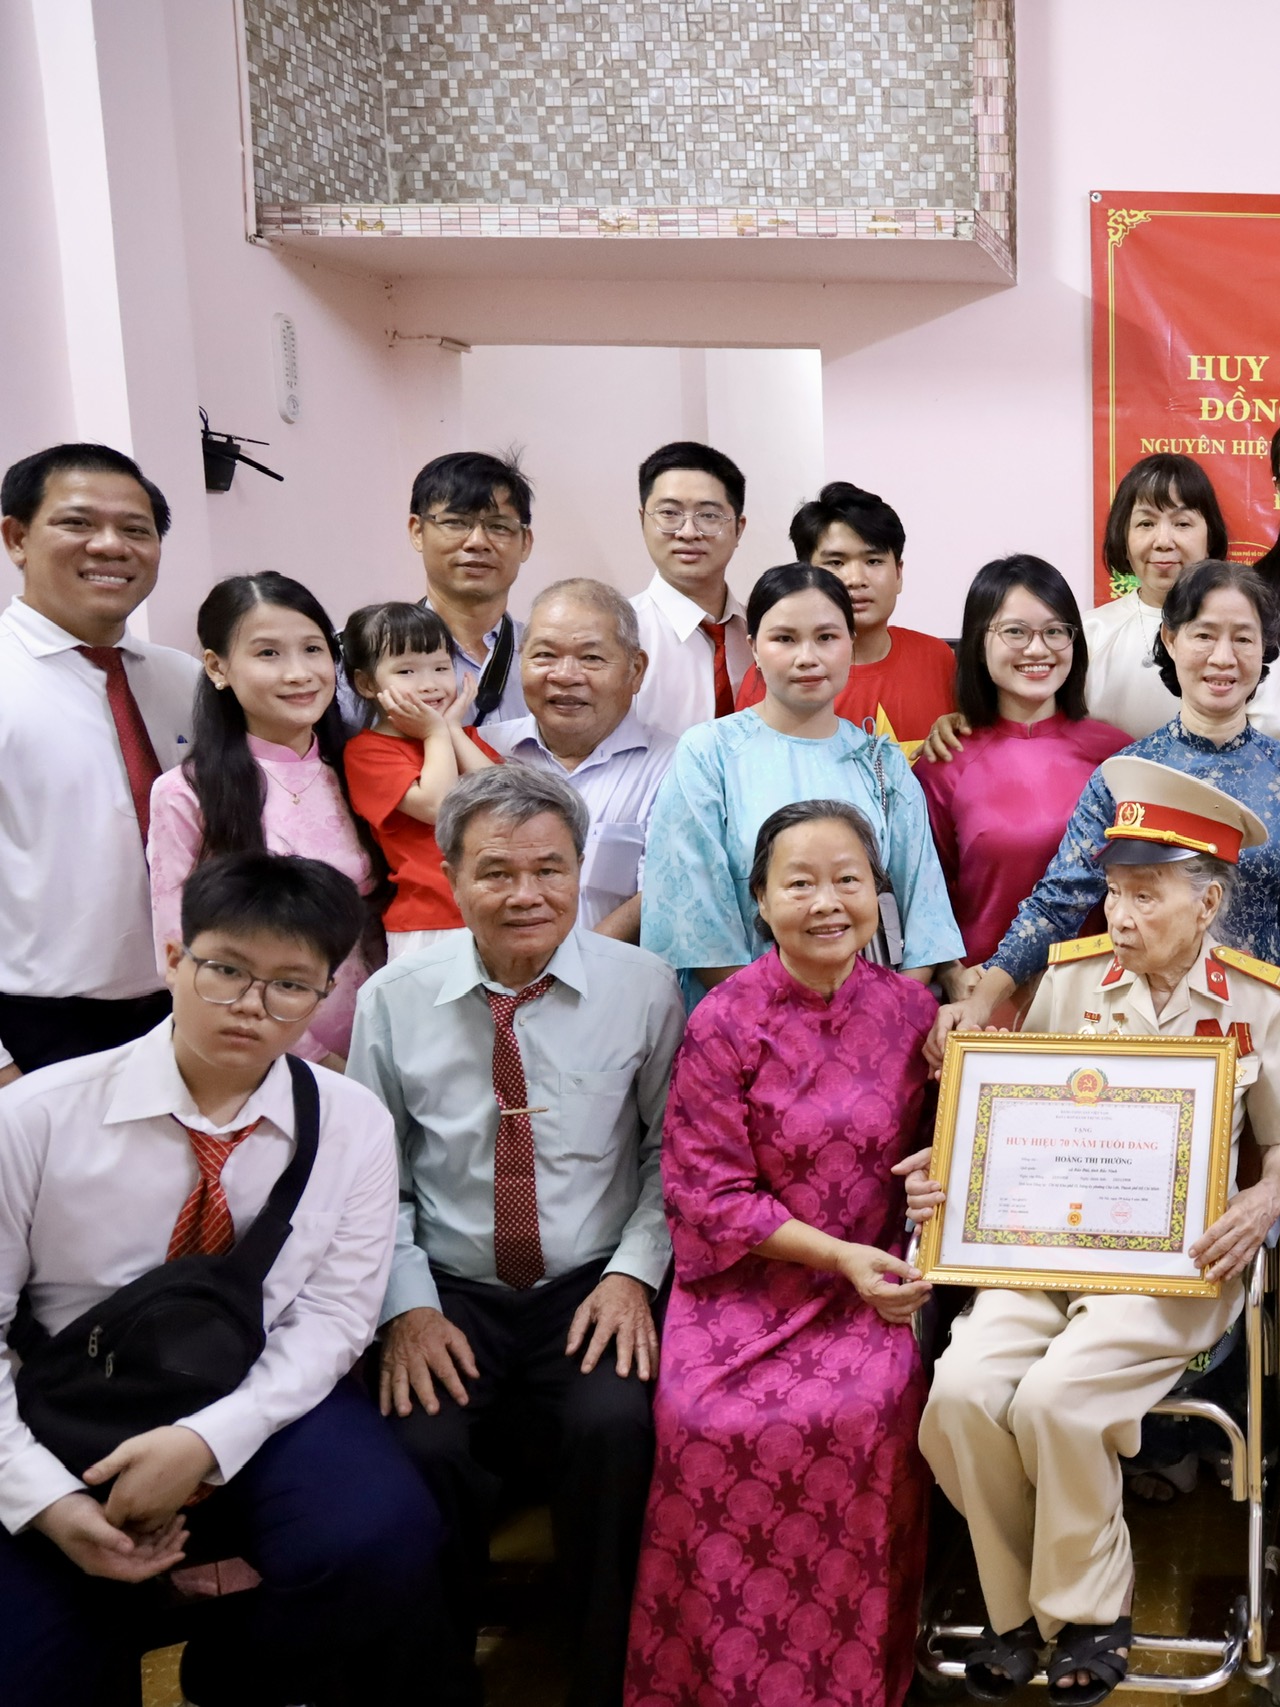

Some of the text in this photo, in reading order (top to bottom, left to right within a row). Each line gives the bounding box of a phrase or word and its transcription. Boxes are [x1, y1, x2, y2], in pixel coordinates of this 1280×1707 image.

[1186, 354, 1270, 383] HUY
[1140, 434, 1227, 455] NGUYÊN
[1231, 436, 1272, 462] HIỆ
[1006, 1137, 1029, 1146] HUY
[1031, 1137, 1056, 1148] HIỆU
[1060, 1138, 1069, 1147] 70
[1072, 1137, 1096, 1148] NĂM
[1055, 1154, 1083, 1163] HOÀNG
[1084, 1157, 1099, 1165] THỊ
